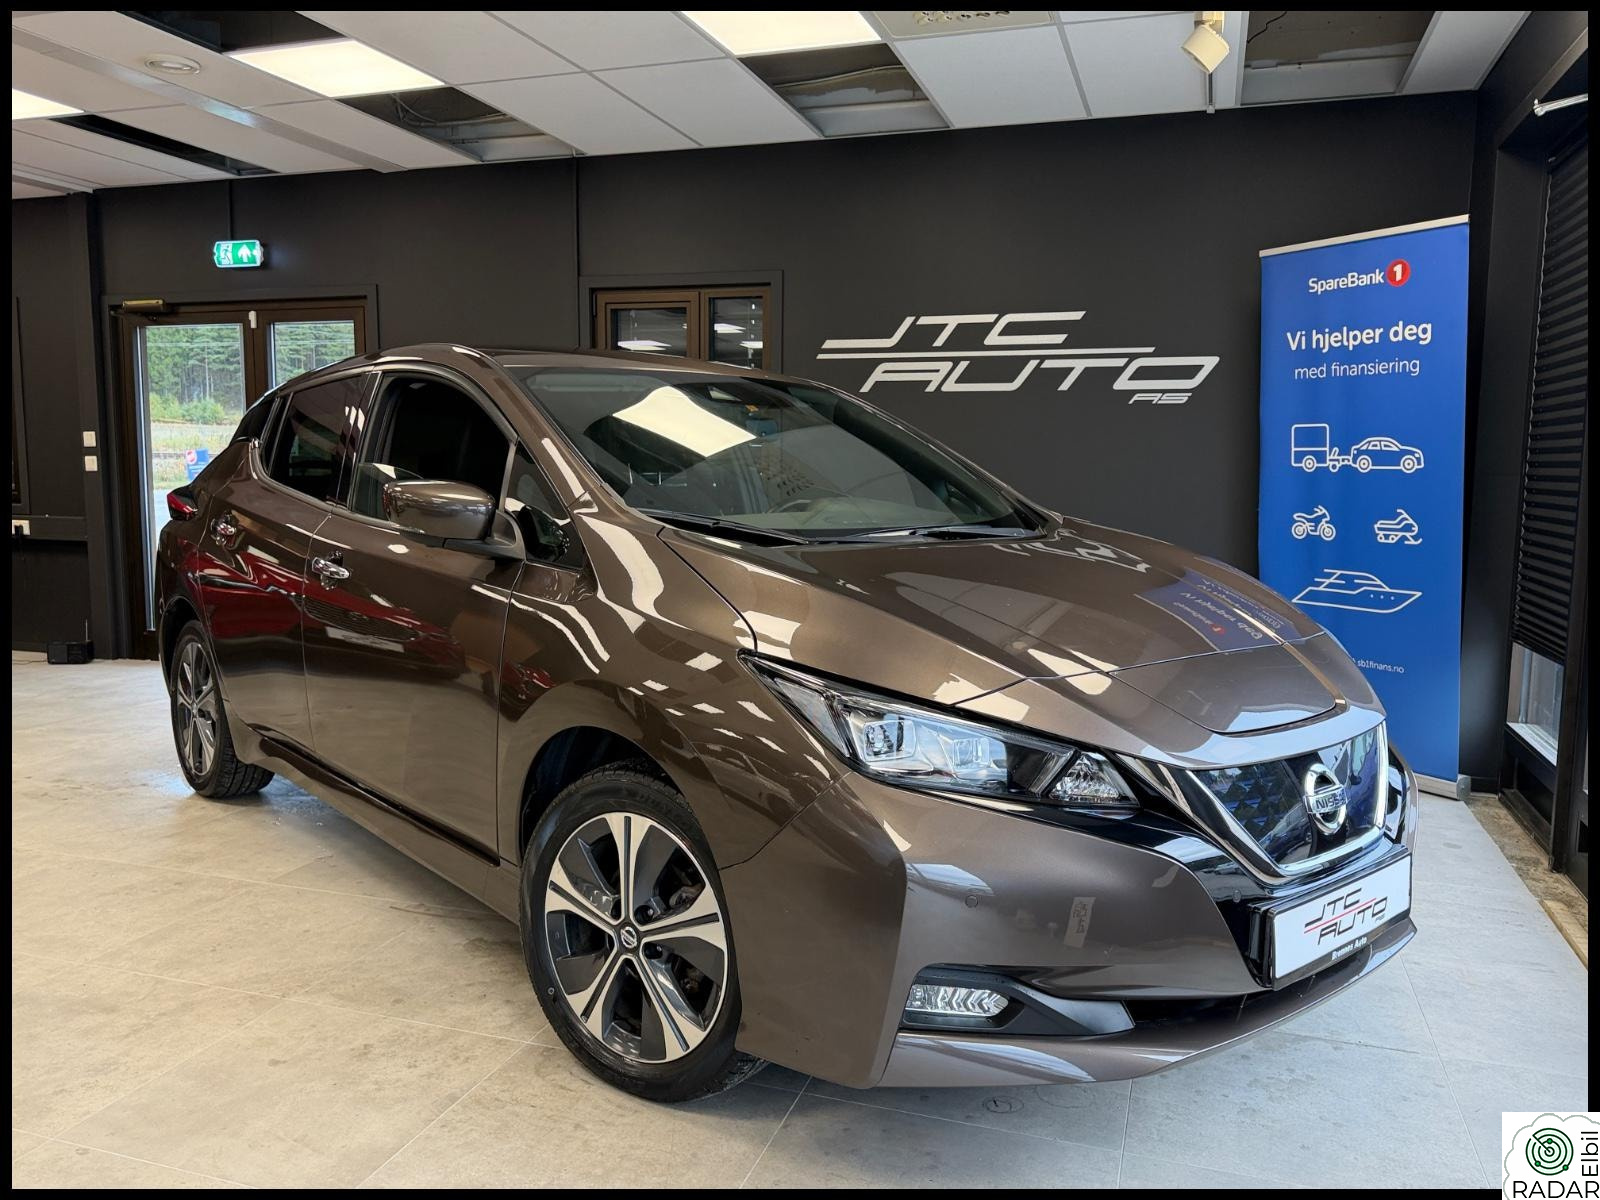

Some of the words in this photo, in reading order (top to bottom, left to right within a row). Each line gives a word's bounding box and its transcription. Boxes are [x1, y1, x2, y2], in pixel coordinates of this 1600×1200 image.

[1308, 268, 1385, 295] SpareBank
[821, 310, 1087, 349] JTC
[1286, 331, 1306, 351] Vi
[1311, 326, 1384, 353] hjelper
[1389, 320, 1433, 345] deg
[858, 355, 1220, 393] AUTO
[1294, 363, 1327, 380] med
[1331, 357, 1420, 378] finansiering
[1127, 392, 1193, 405] AS
[1305, 888, 1362, 928] JTC
[1317, 896, 1388, 945] AUTO
